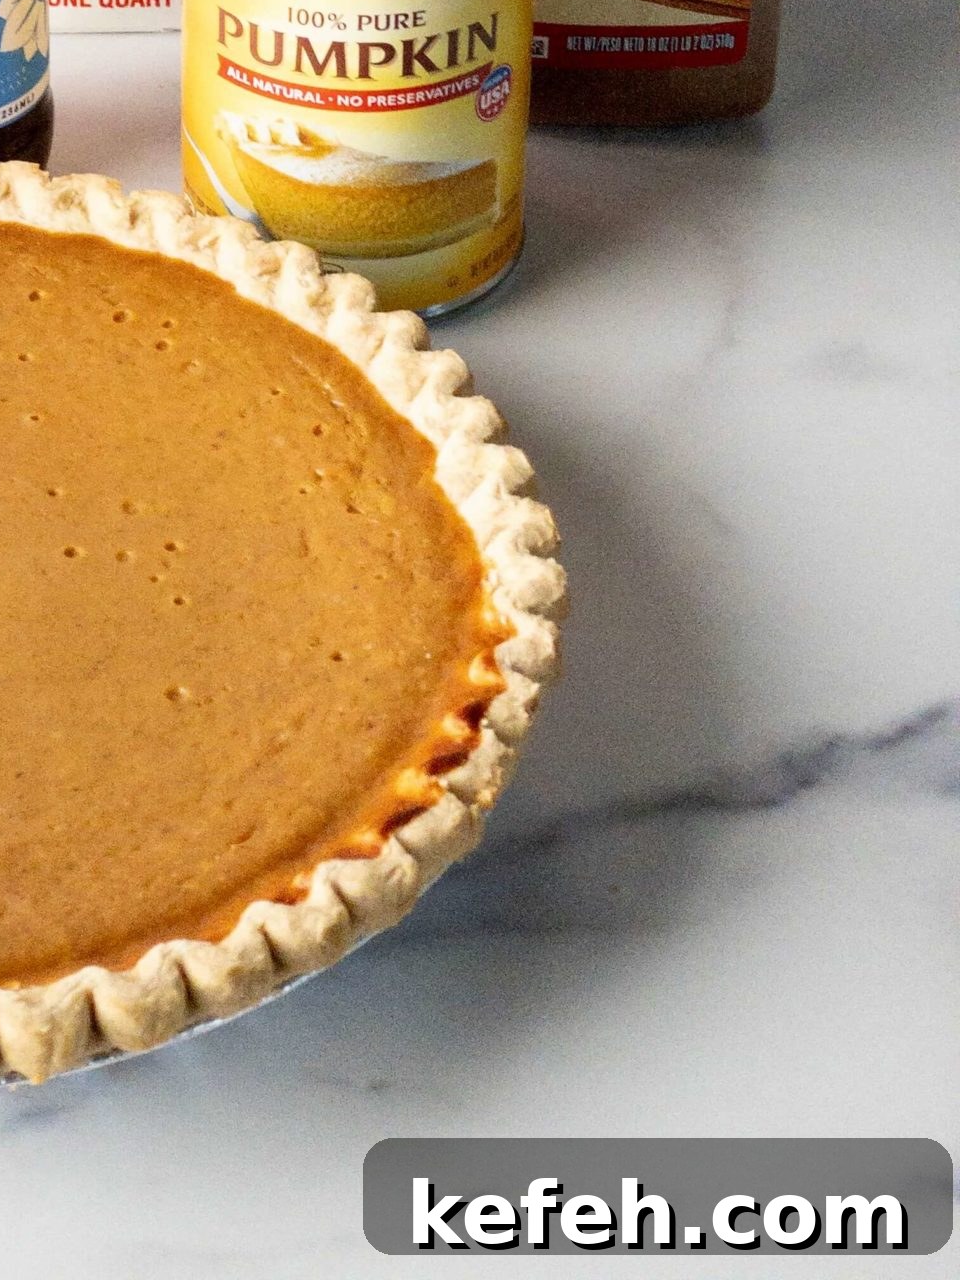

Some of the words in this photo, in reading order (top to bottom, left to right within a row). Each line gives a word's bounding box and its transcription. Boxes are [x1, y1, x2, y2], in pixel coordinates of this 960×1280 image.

[287, 7, 348, 31] 100%
[356, 10, 427, 31] PURE
[217, 6, 500, 81] PUMPKIN
[566, 35, 582, 51] NET
[226, 65, 251, 86] ALL
[252, 78, 325, 105] NATURAL
[336, 94, 363, 107] NO
[367, 74, 480, 107] PRESERVATIVES
[480, 79, 510, 110] USA
